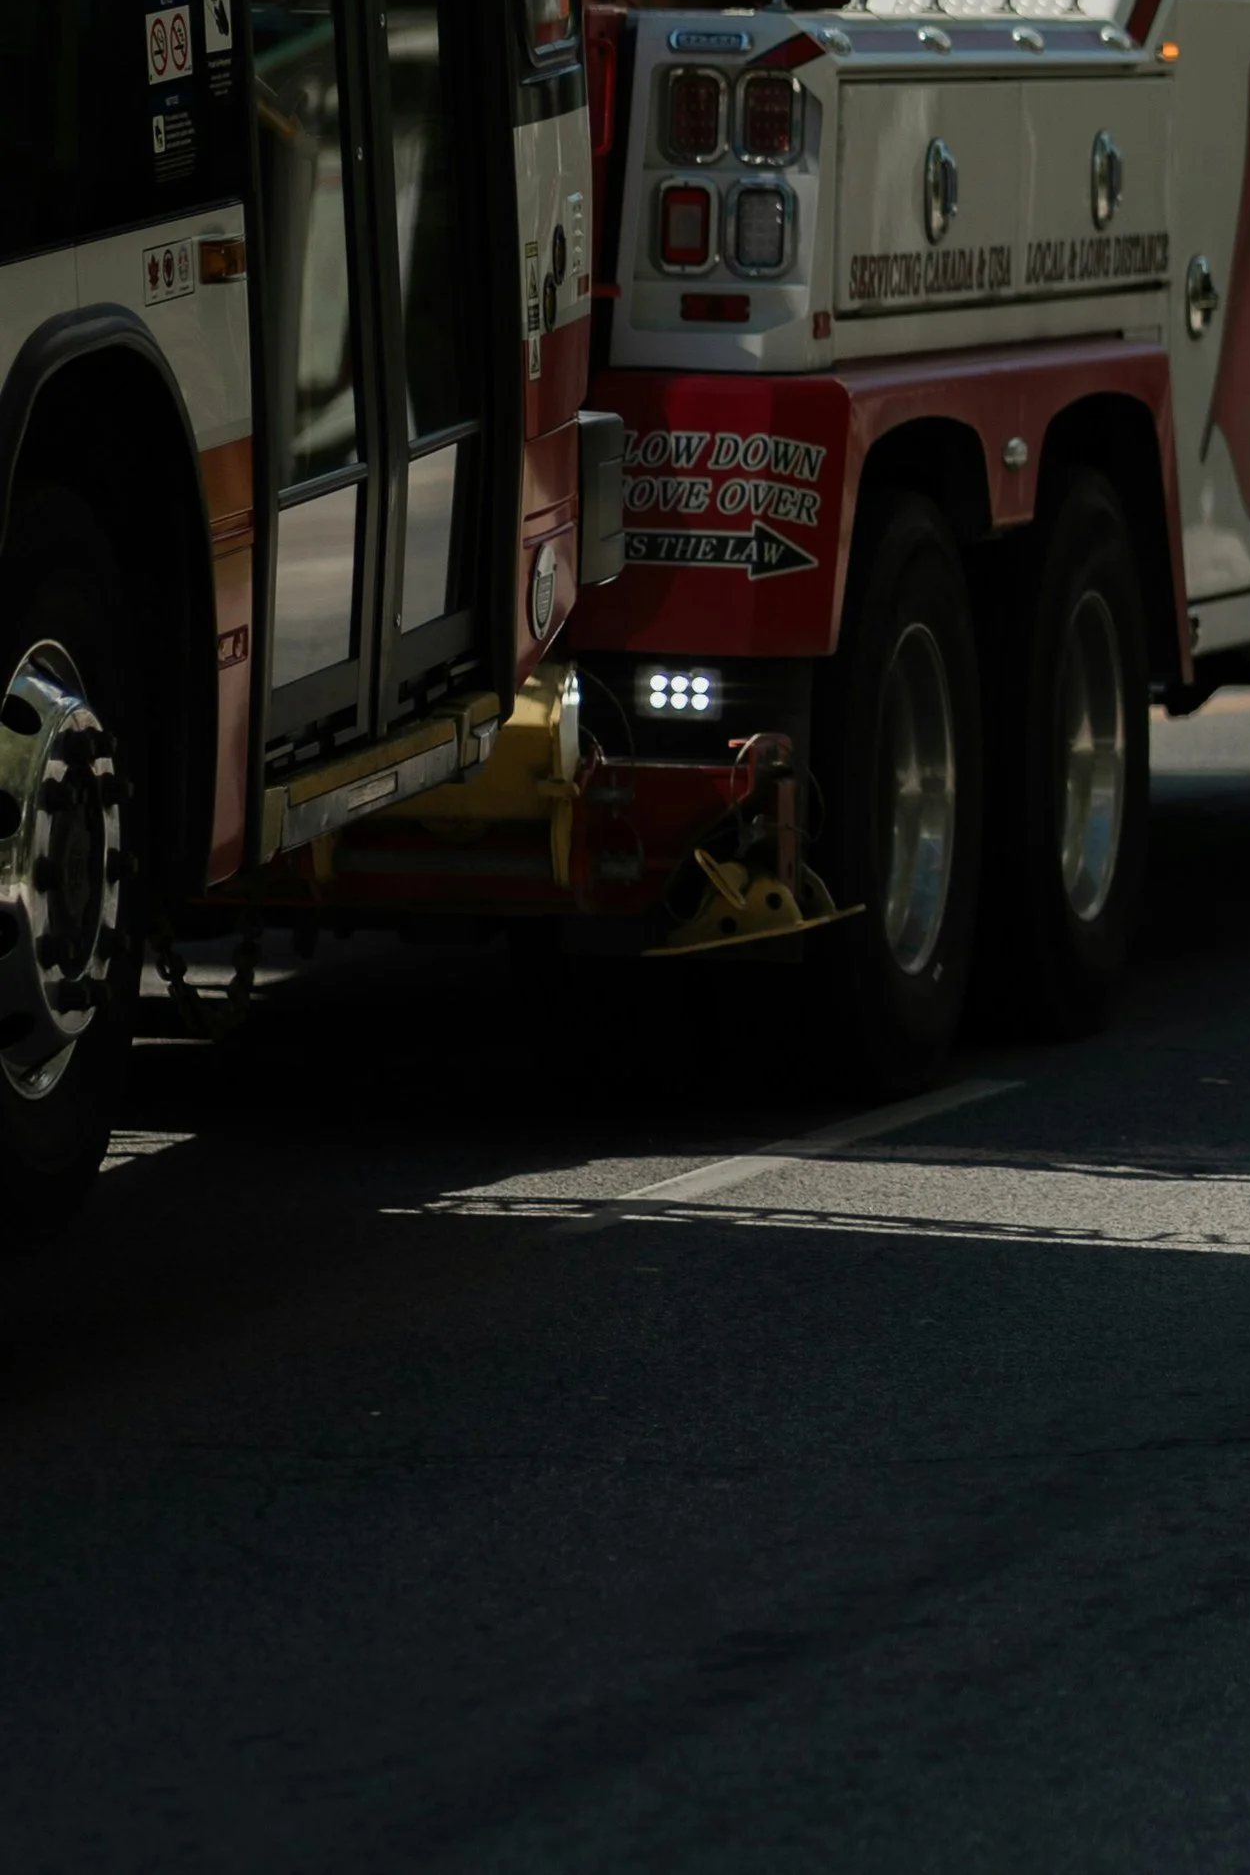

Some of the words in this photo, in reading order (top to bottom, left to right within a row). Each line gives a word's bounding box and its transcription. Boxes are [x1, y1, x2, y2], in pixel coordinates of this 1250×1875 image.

[849, 251, 923, 301] SERVICING
[923, 247, 974, 293] CANADA
[988, 244, 1012, 290] USA
[1025, 239, 1066, 284] LOCAL
[1078, 235, 1111, 279] LONG
[1112, 231, 1169, 277] DISTANCE
[623, 430, 710, 468] LOW
[708, 433, 825, 479] DOWN
[622, 475, 713, 515] OVE
[717, 478, 820, 526] OVER
[656, 536, 718, 560] THE
[723, 539, 784, 565] LAW
